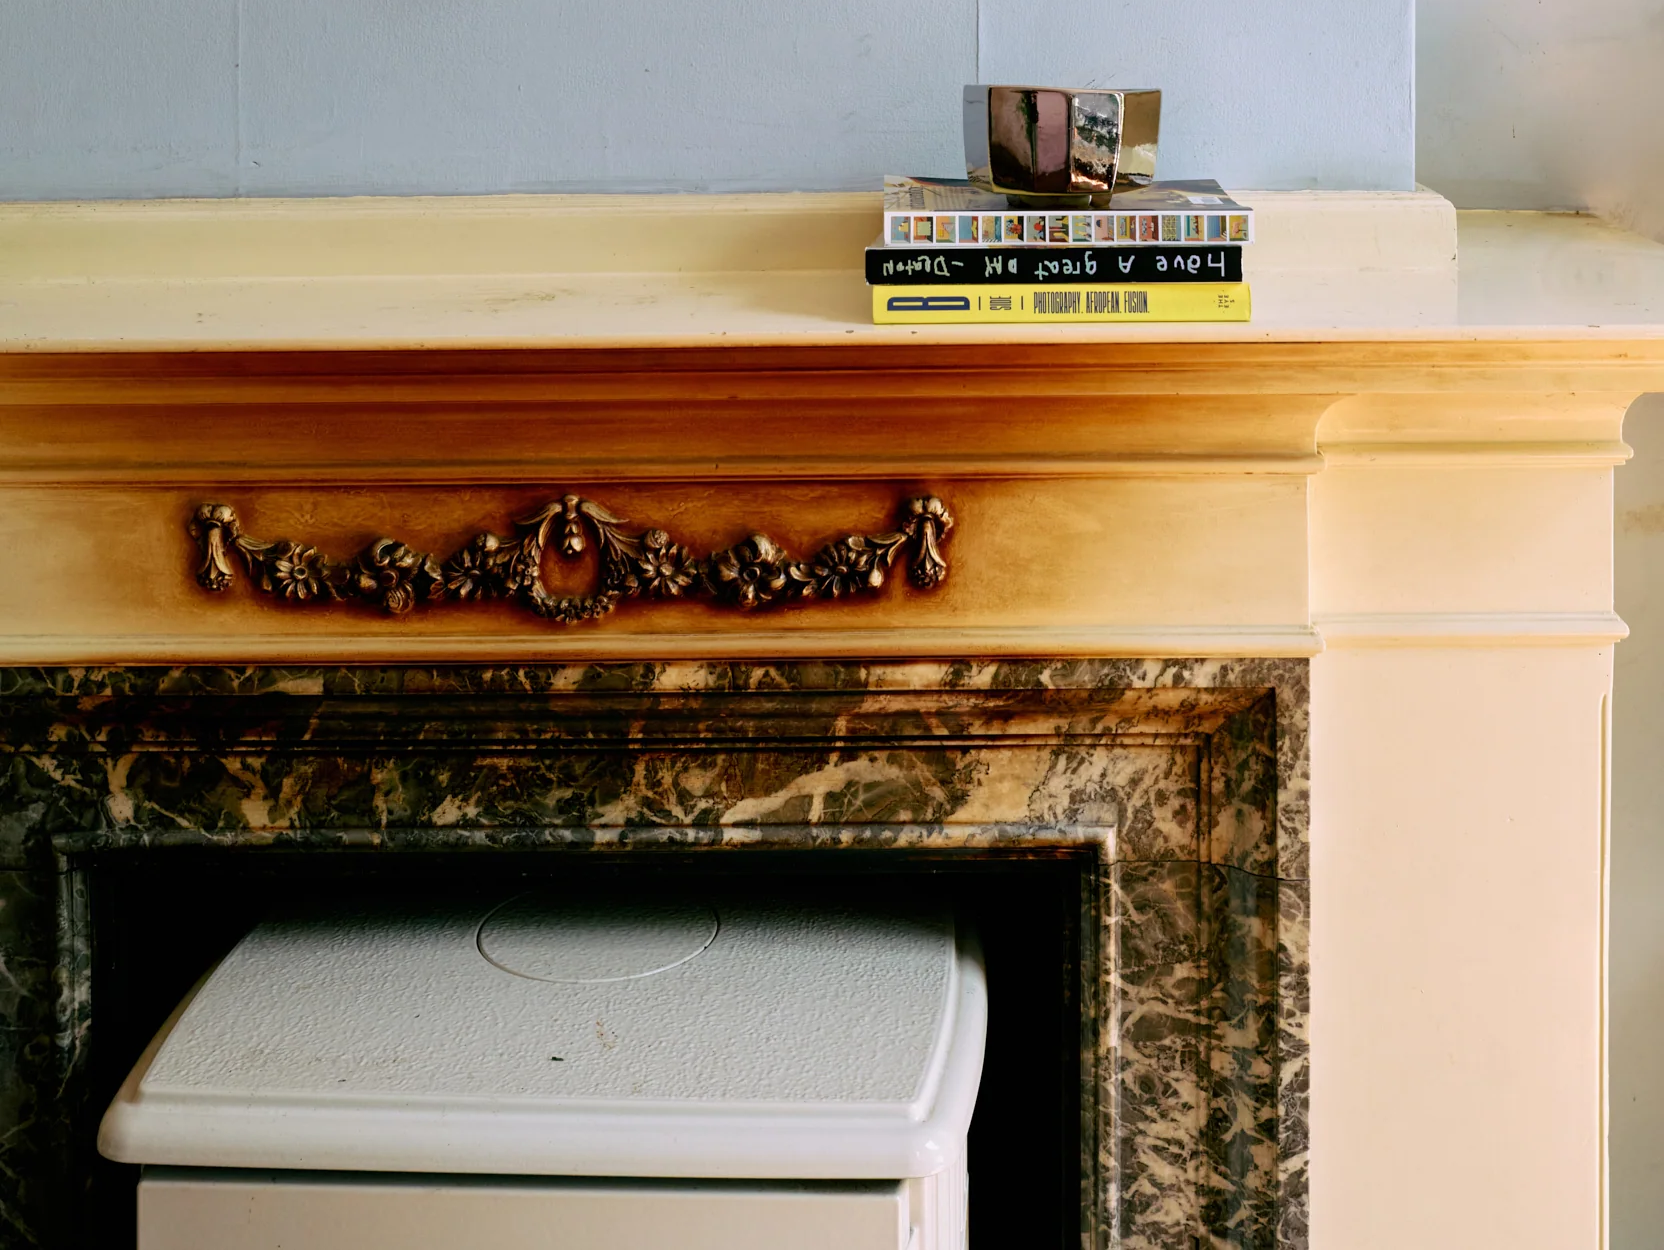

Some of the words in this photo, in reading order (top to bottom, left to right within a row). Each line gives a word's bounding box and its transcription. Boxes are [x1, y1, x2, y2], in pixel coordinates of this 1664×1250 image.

[985, 255, 1017, 277] DAY
[1034, 251, 1097, 280] great
[1118, 255, 1135, 273] A
[989, 296, 1012, 310] SIDE
[1033, 291, 1083, 314] PHOTOGRAPHY.
[1085, 291, 1122, 314] AFROPEAN.
[1124, 291, 1150, 314] FUSION.
